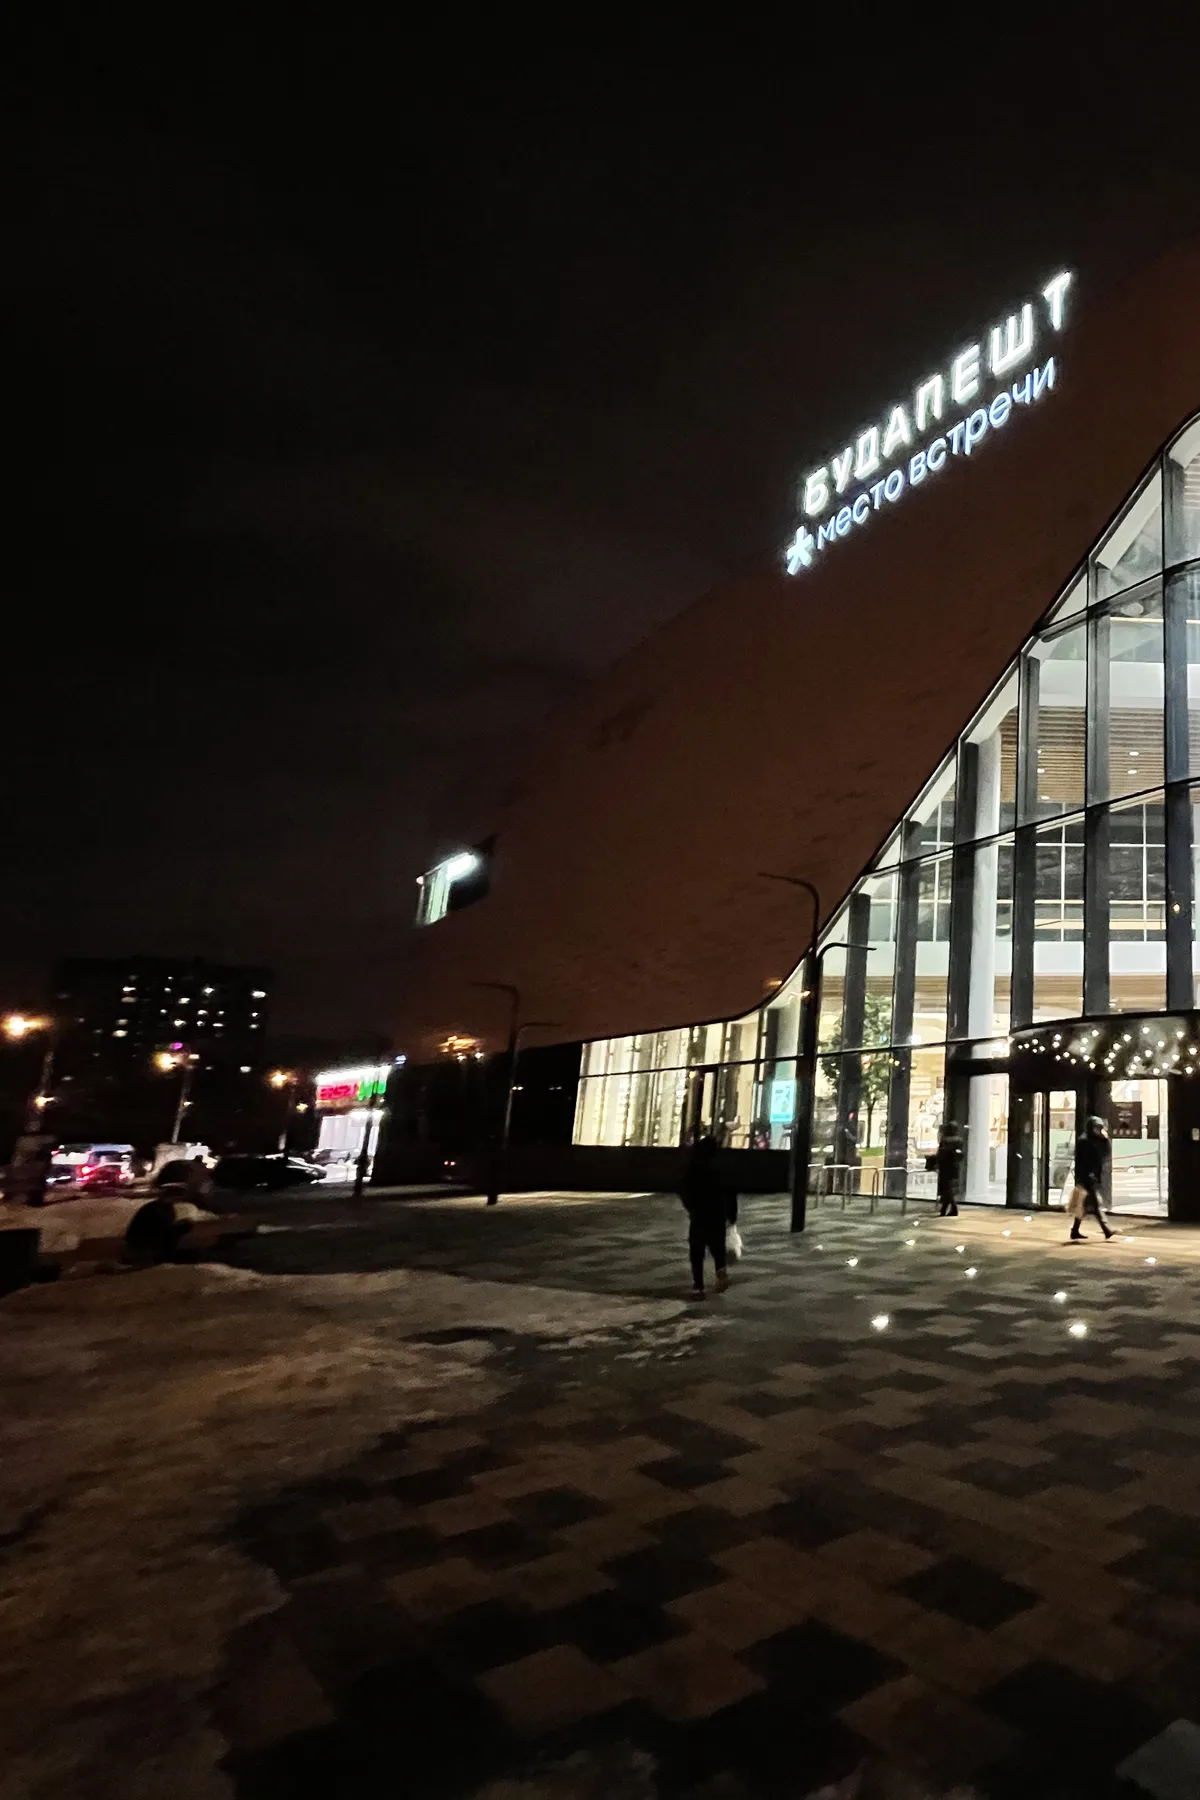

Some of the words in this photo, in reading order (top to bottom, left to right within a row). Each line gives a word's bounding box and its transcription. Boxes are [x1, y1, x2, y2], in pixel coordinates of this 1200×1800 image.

[803, 270, 1072, 516] БУДАПЕШТ
[816, 469, 905, 550] место
[908, 356, 1056, 486] встречи
